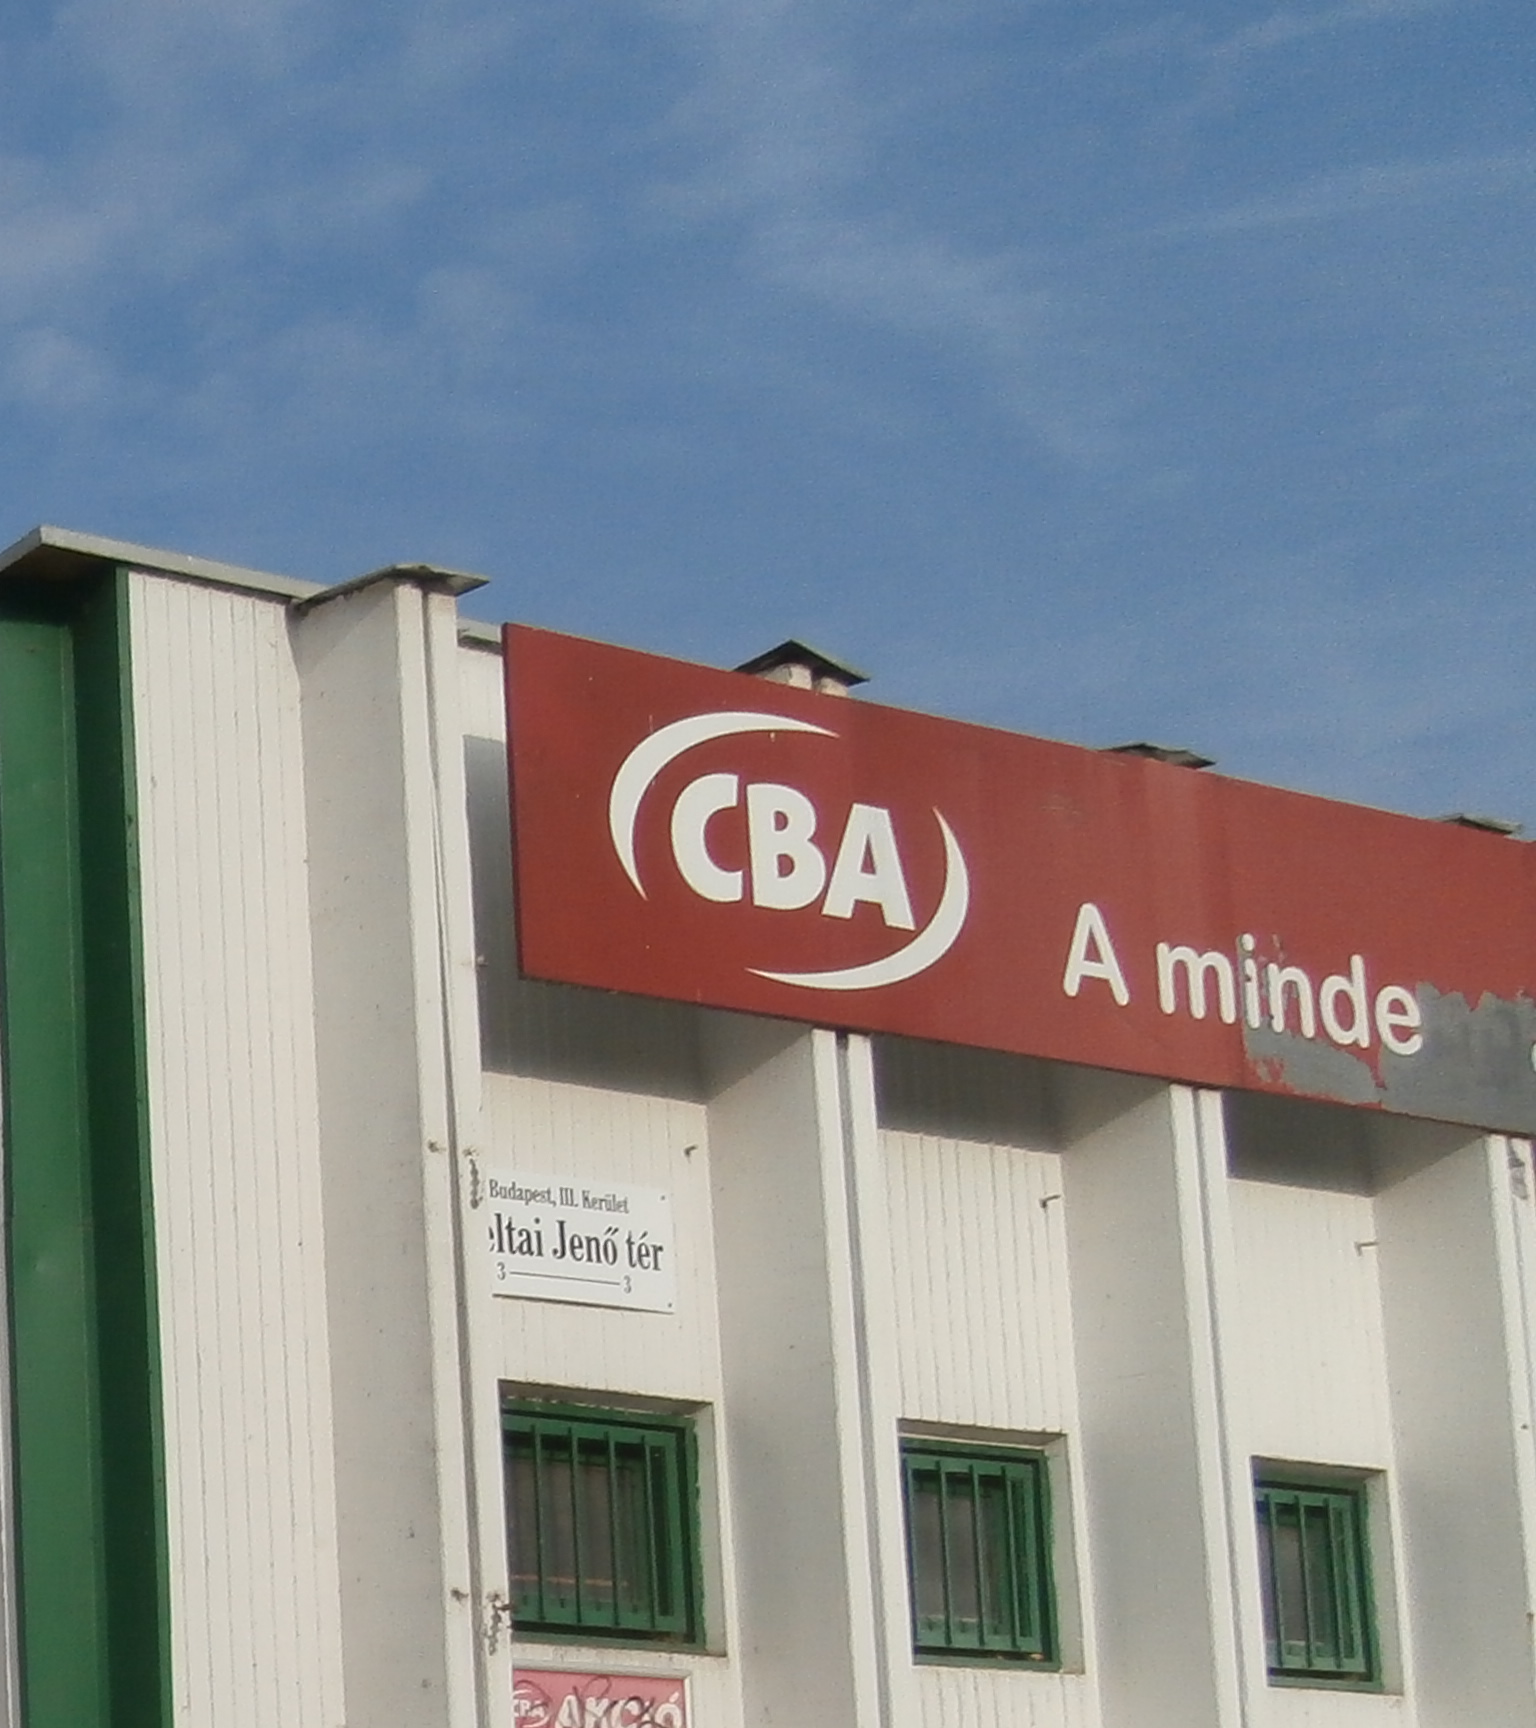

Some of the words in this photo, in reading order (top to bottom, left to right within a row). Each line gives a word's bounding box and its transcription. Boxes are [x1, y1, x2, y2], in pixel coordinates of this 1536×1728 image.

[671, 772, 916, 931] CBA
[1063, 902, 1128, 1005] A
[488, 1178, 557, 1208] Budapest,
[559, 1186, 579, 1208] III.
[581, 1189, 630, 1214] Kerület
[552, 1219, 618, 1266] Jenő
[625, 1230, 664, 1272] tér
